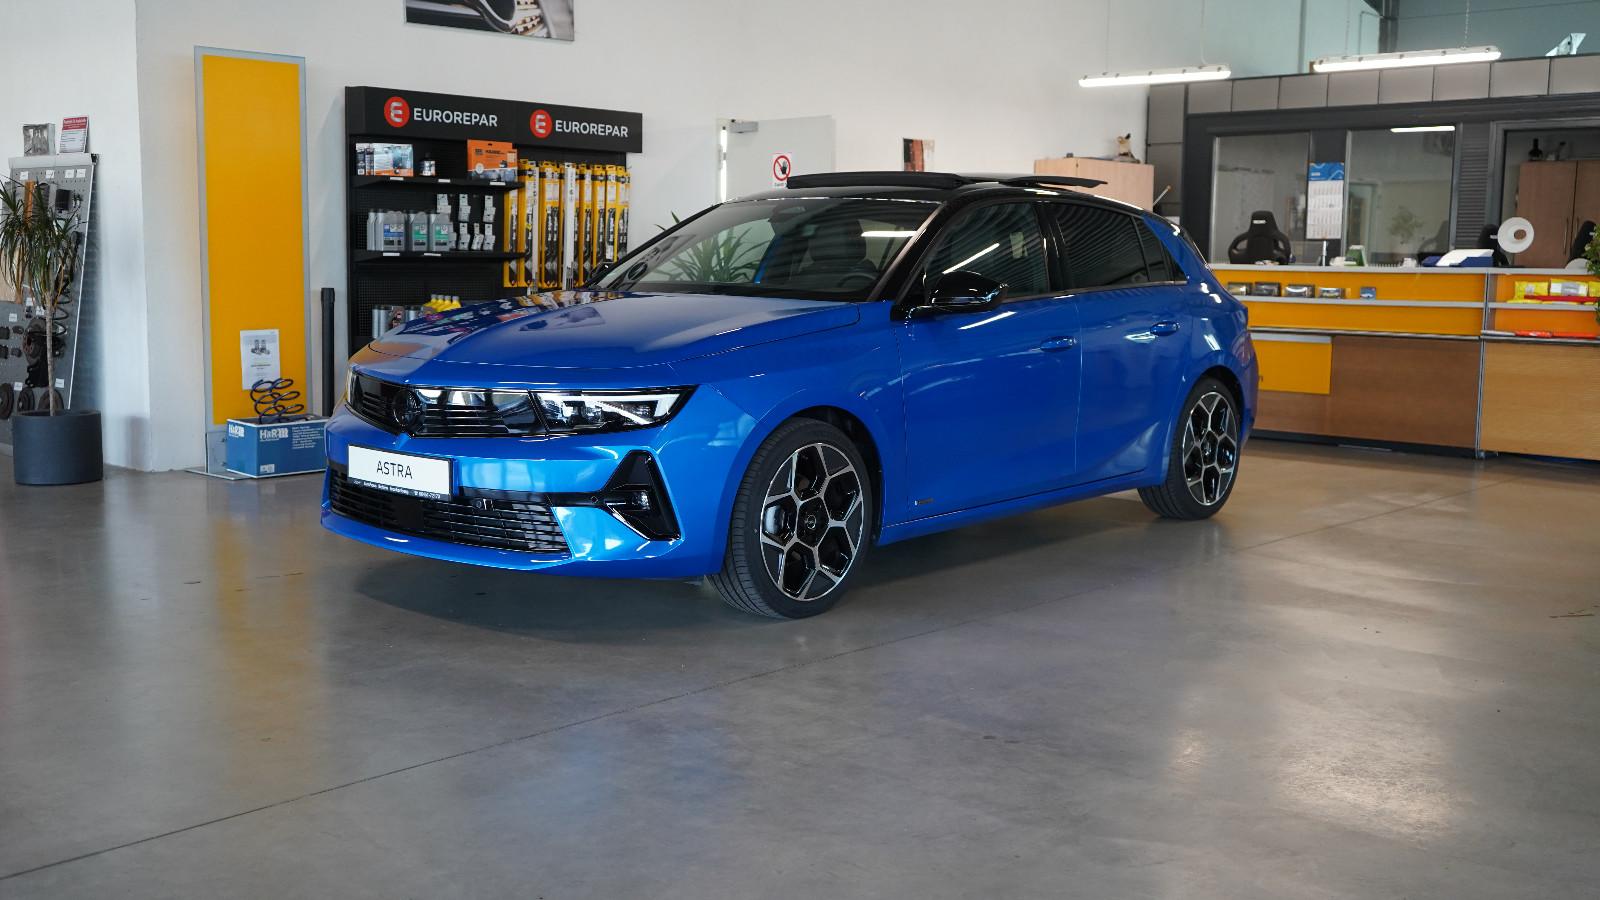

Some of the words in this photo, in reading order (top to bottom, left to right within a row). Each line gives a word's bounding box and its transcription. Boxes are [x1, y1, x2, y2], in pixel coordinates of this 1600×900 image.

[413, 107, 498, 127] EUROREPAR
[555, 119, 629, 138] EUROREPAR
[376, 460, 413, 479] ASTRA
